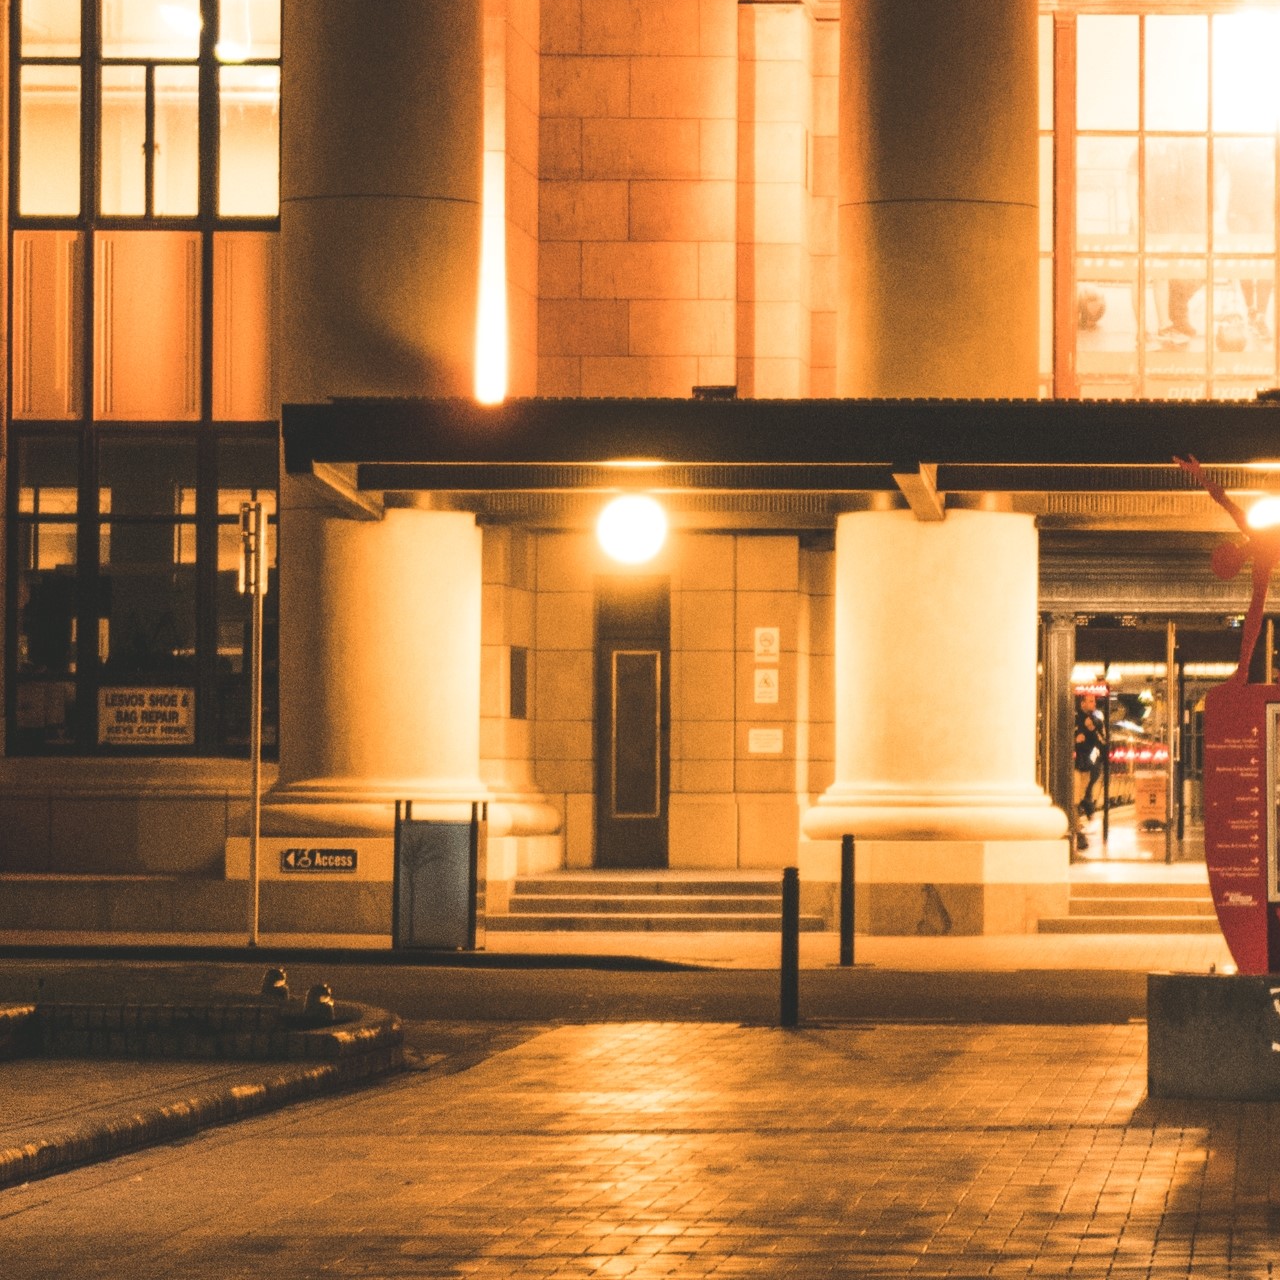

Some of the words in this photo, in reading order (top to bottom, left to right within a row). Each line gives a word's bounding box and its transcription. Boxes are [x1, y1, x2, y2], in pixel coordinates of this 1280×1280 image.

[105, 694, 146, 707] LESVOS
[149, 694, 178, 707] SHOE
[181, 694, 189, 707] &
[115, 710, 138, 723] BAG
[141, 710, 179, 723] REPAIR
[315, 852, 353, 867] Access
